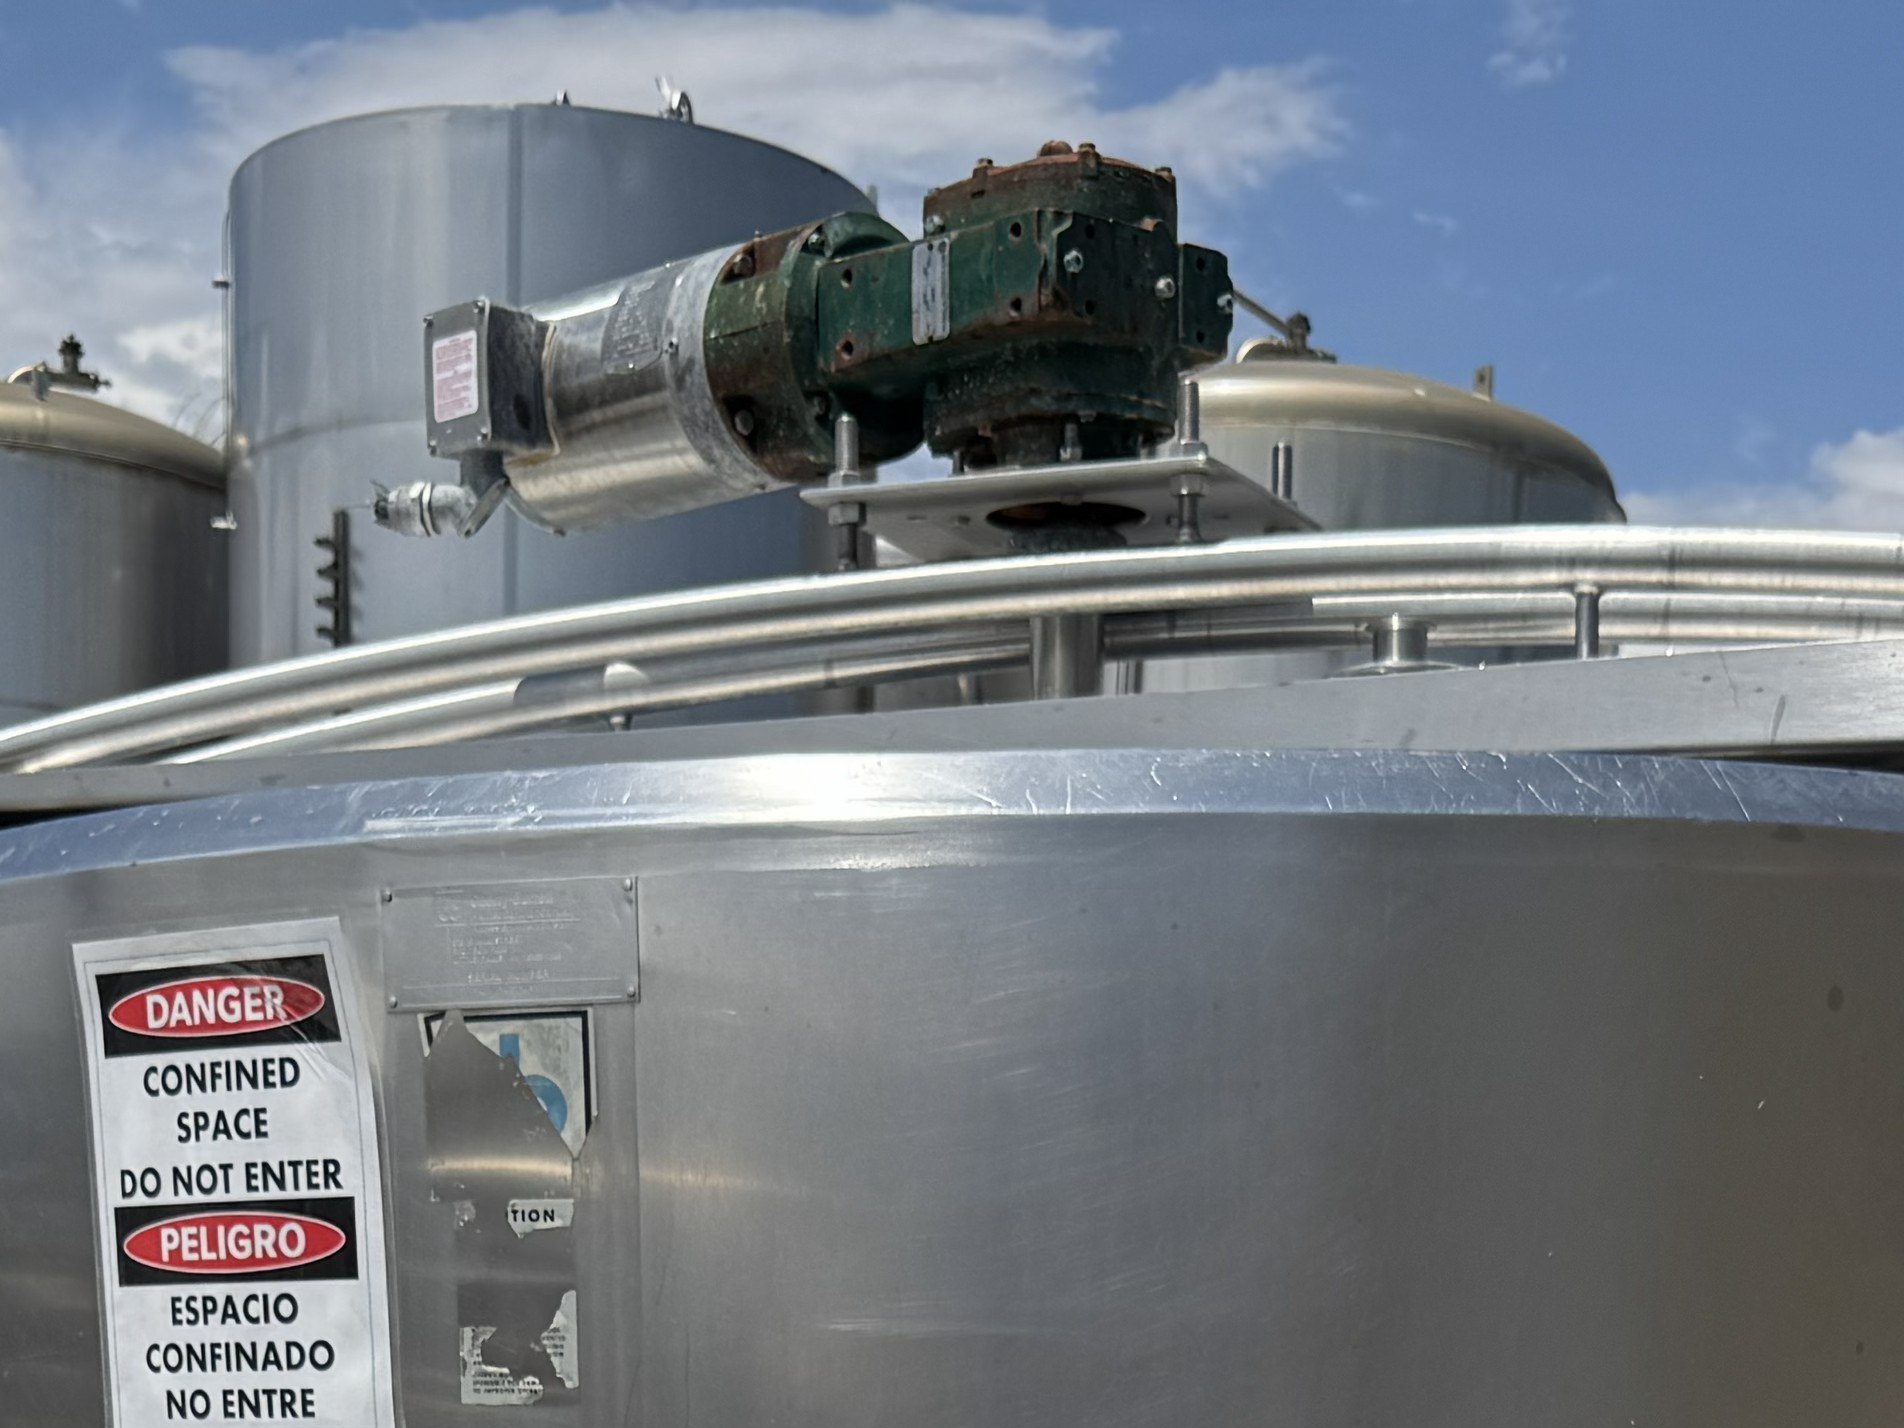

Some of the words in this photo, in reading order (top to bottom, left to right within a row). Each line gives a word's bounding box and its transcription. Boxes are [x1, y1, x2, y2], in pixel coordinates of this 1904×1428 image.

[146, 985, 287, 1029] DANGER
[144, 1057, 300, 1097] CONFINED
[177, 1107, 269, 1143] SPACE
[120, 1167, 161, 1199] DO
[173, 1163, 233, 1196] NOT
[245, 1158, 344, 1193] ENTER
[506, 1208, 556, 1223] TION
[160, 1222, 306, 1263] PELIGRO
[171, 1293, 299, 1326] ESPACIO
[146, 1340, 335, 1373] CONFINADO
[166, 1389, 211, 1419] NO
[222, 1388, 316, 1418] ENTRE
